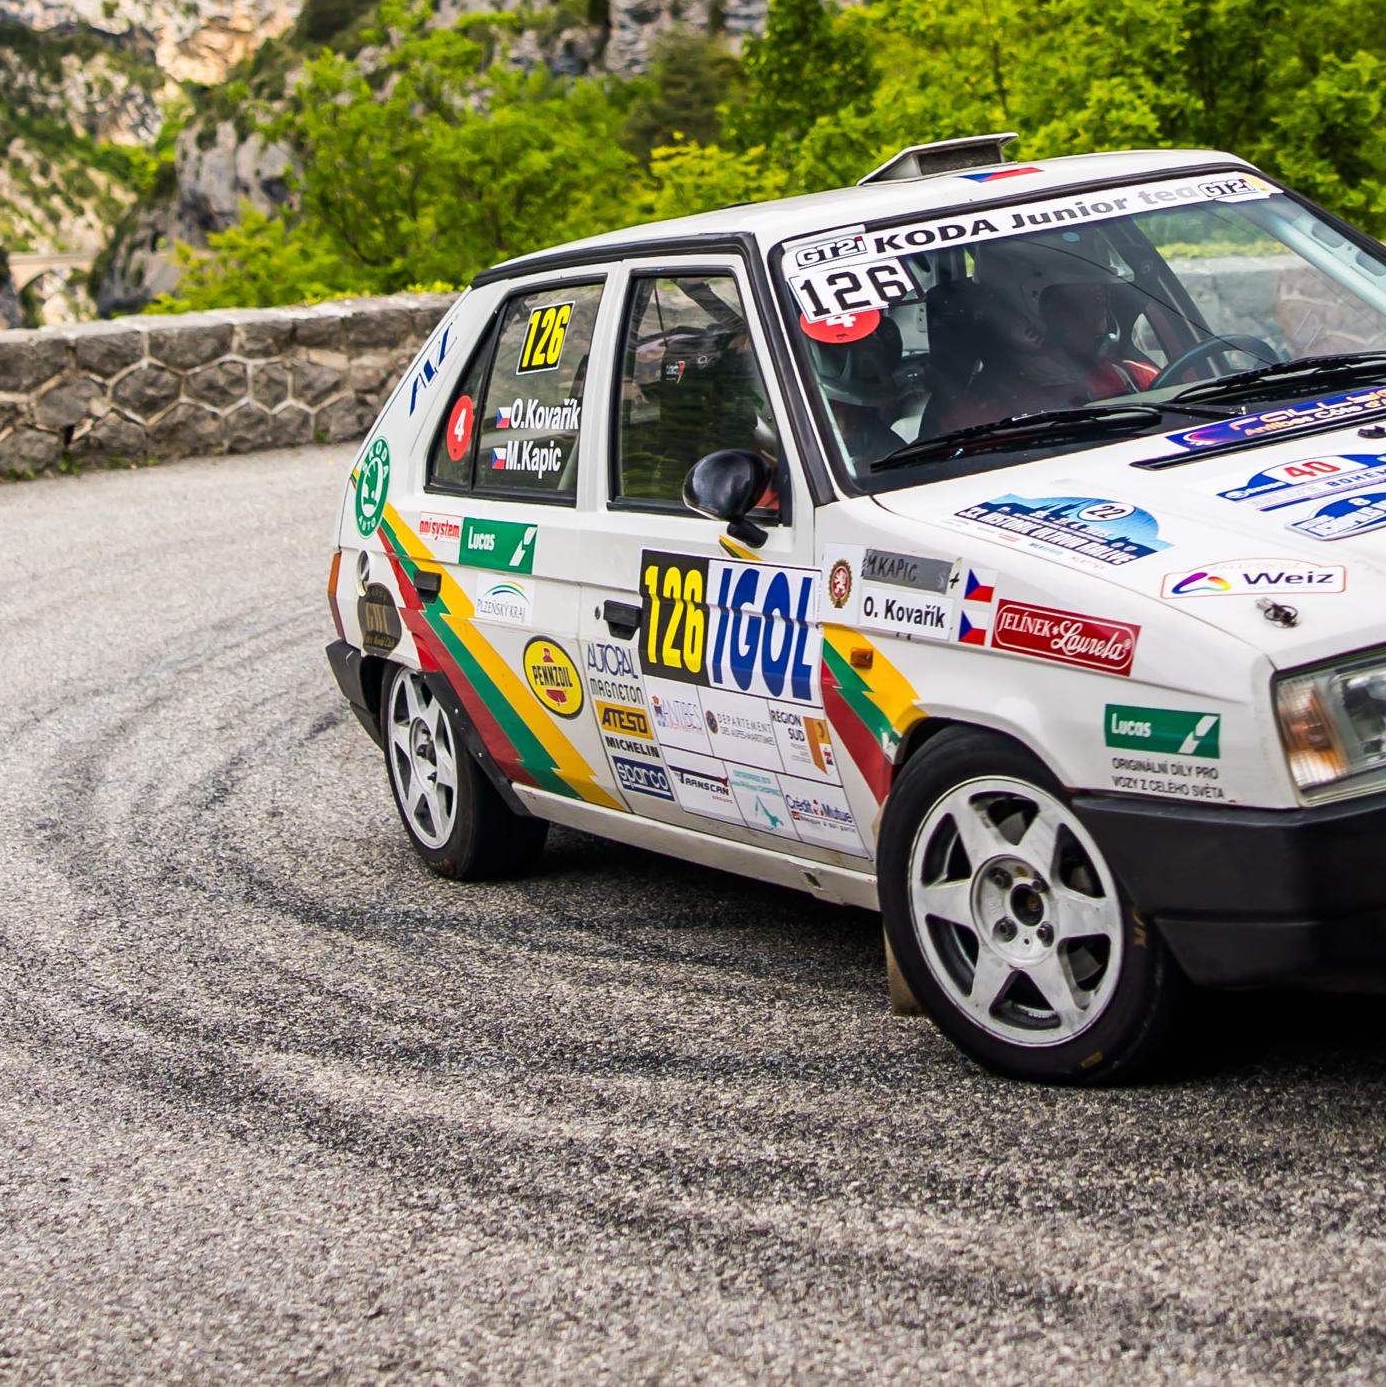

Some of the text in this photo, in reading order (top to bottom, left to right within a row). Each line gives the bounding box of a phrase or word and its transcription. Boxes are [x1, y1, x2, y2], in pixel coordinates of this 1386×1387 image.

[1198, 177, 1257, 198] GT2i
[874, 185, 1199, 254] KODA Junior tea
[796, 235, 867, 268] GT2i
[800, 265, 908, 317] 126
[521, 305, 571, 367] 126
[454, 409, 466, 442] 4
[511, 398, 581, 430] O.Kovařík
[506, 440, 562, 480] M.Kapic
[1283, 460, 1341, 478] 40
[1087, 505, 1126, 519] 22
[467, 526, 496, 551] Lucas
[980, 512, 1043, 538] HISTORIC
[1030, 524, 1090, 550] VLTAVA
[1075, 541, 1139, 565] RALLYE
[1242, 571, 1334, 585] Weiz
[644, 565, 705, 673] 126
[863, 596, 946, 628] O. Kovařík
[998, 611, 1054, 638] JELÍNEK
[712, 567, 813, 701] IGOL
[587, 643, 638, 680] AUTOPAL
[532, 665, 573, 688] PENNZOIL
[590, 678, 645, 705] MAGNETON
[601, 707, 648, 734] ATESO
[1111, 713, 1152, 738] Lucas
[604, 736, 660, 758] MICHELIN
[787, 727, 805, 742] SUD
[616, 763, 669, 791] sparco
[1111, 757, 1219, 780] ORIGINÁLNÍ DÍLY PRO
[1112, 775, 1226, 800] VOZY Z CELÉHO SVĚTA
